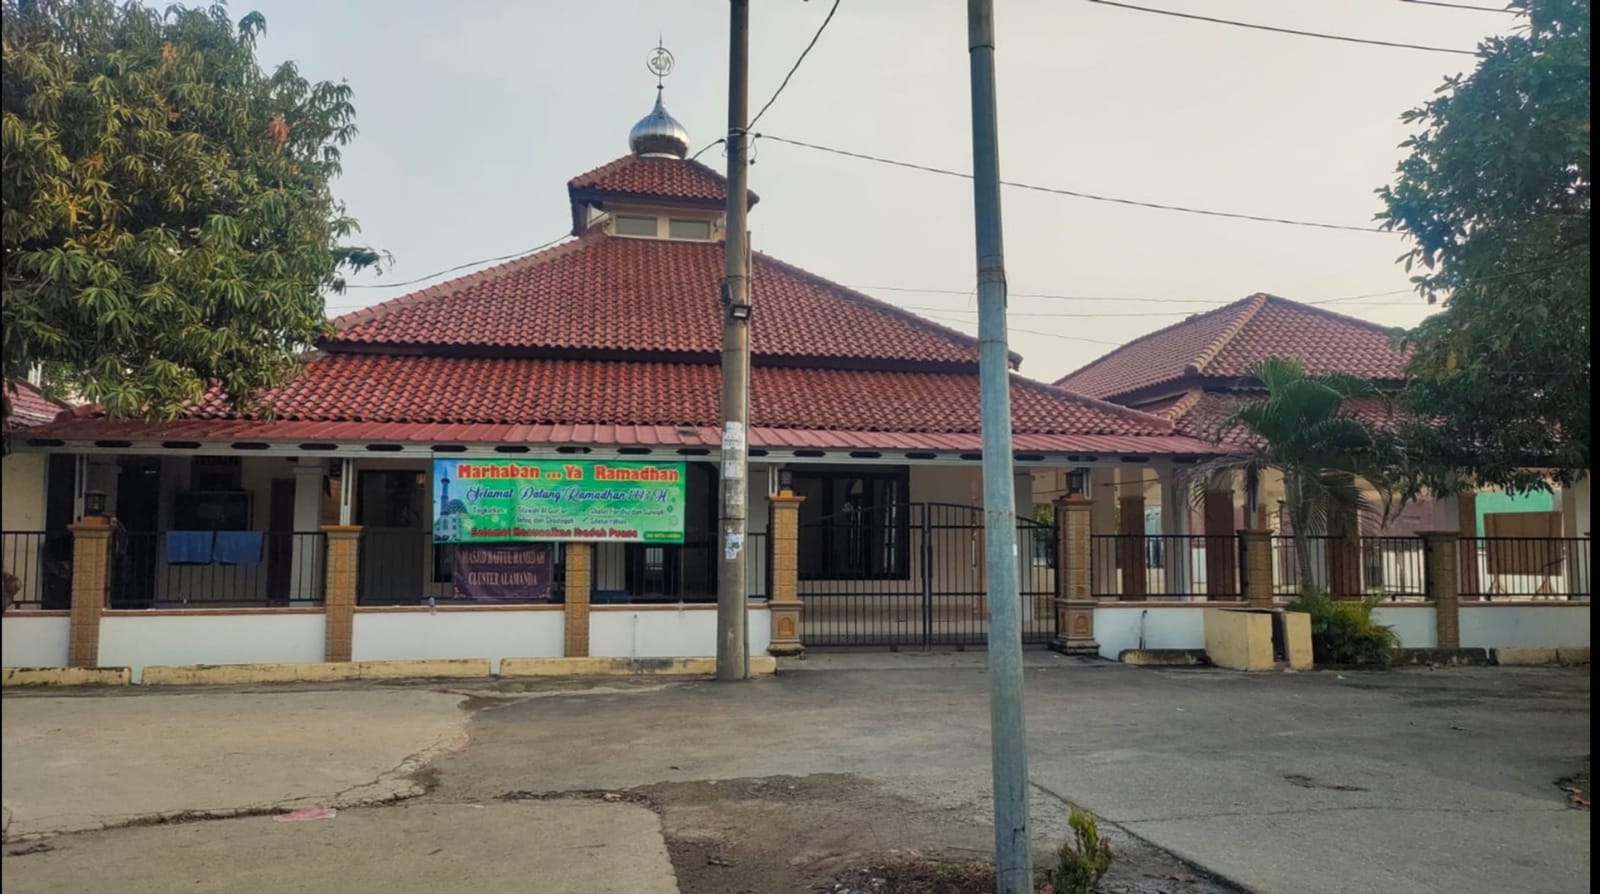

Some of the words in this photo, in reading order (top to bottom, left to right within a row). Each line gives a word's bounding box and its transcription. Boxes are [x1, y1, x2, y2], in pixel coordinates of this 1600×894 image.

[457, 464, 540, 479] Marhaban
[564, 465, 583, 480] Ya
[595, 465, 679, 481] Ramadhan
[466, 487, 514, 503] Selamat
[519, 486, 561, 503] Datang
[565, 485, 625, 503] Ramadhan
[468, 571, 499, 585] CLUSTER
[501, 571, 538, 586] ALAMANDA
